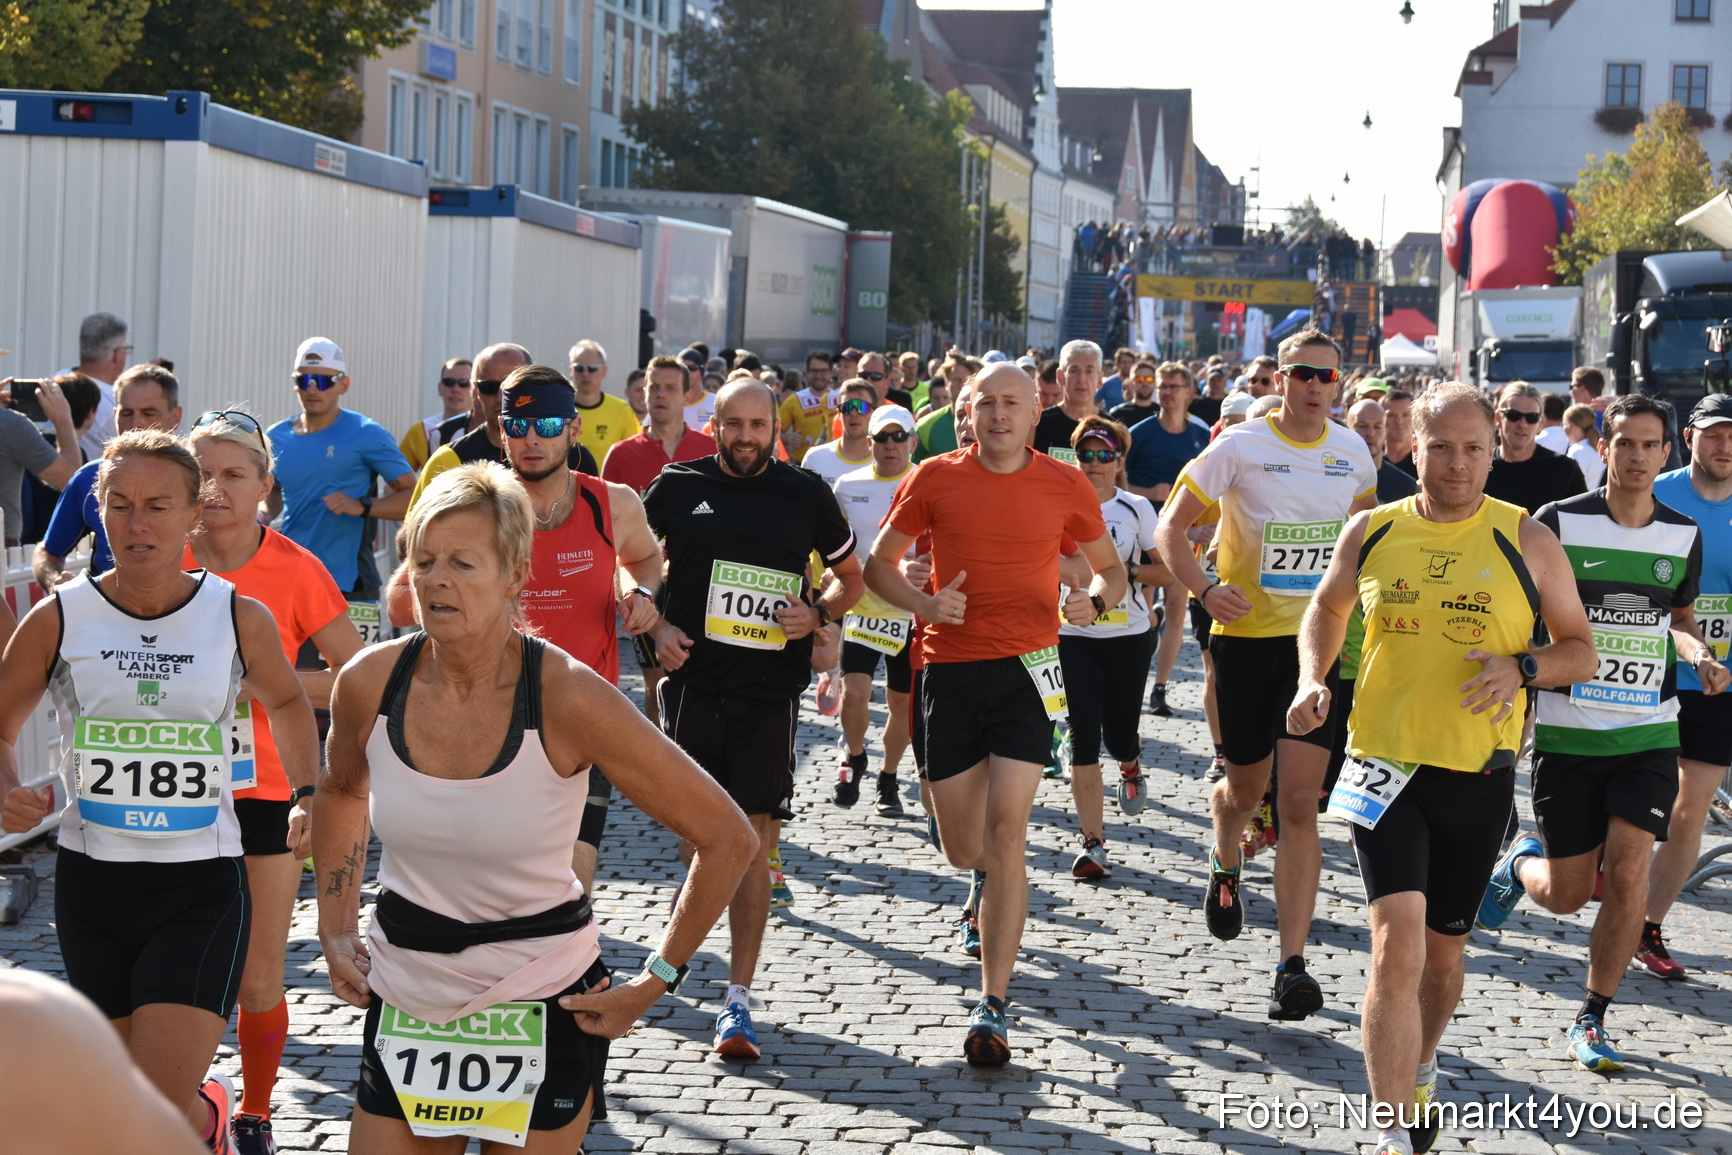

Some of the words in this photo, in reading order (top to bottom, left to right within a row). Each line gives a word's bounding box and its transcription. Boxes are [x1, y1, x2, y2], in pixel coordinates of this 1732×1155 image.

[1194, 281, 1255, 299] START
[1271, 524, 1338, 541] BOCK
[557, 550, 593, 560] HEINLOTH
[1272, 547, 1335, 571] 2775
[1420, 547, 1463, 556] FONDSZENTRUM
[719, 566, 793, 594] BOCK
[1421, 578, 1453, 586] NEUMARKT
[1380, 590, 1420, 600] NEUMARKTER
[1395, 617, 1406, 629] &
[1411, 618, 1420, 630] S
[1446, 616, 1487, 631] PIZZERIA
[1588, 608, 1657, 624] MAGNERS
[732, 625, 768, 640] SVEN
[851, 630, 899, 649] CHRISTOPH
[115, 650, 194, 664] INTERSPORT
[119, 661, 182, 674] LANGE
[126, 672, 170, 680] AMBERG
[1580, 686, 1652, 704] WOLFGANG
[85, 720, 213, 752] BOCK
[91, 758, 207, 799] 2183
[125, 810, 169, 827] EVA
[396, 1048, 523, 1093] 1107
[414, 1103, 484, 1121] HEIDI
